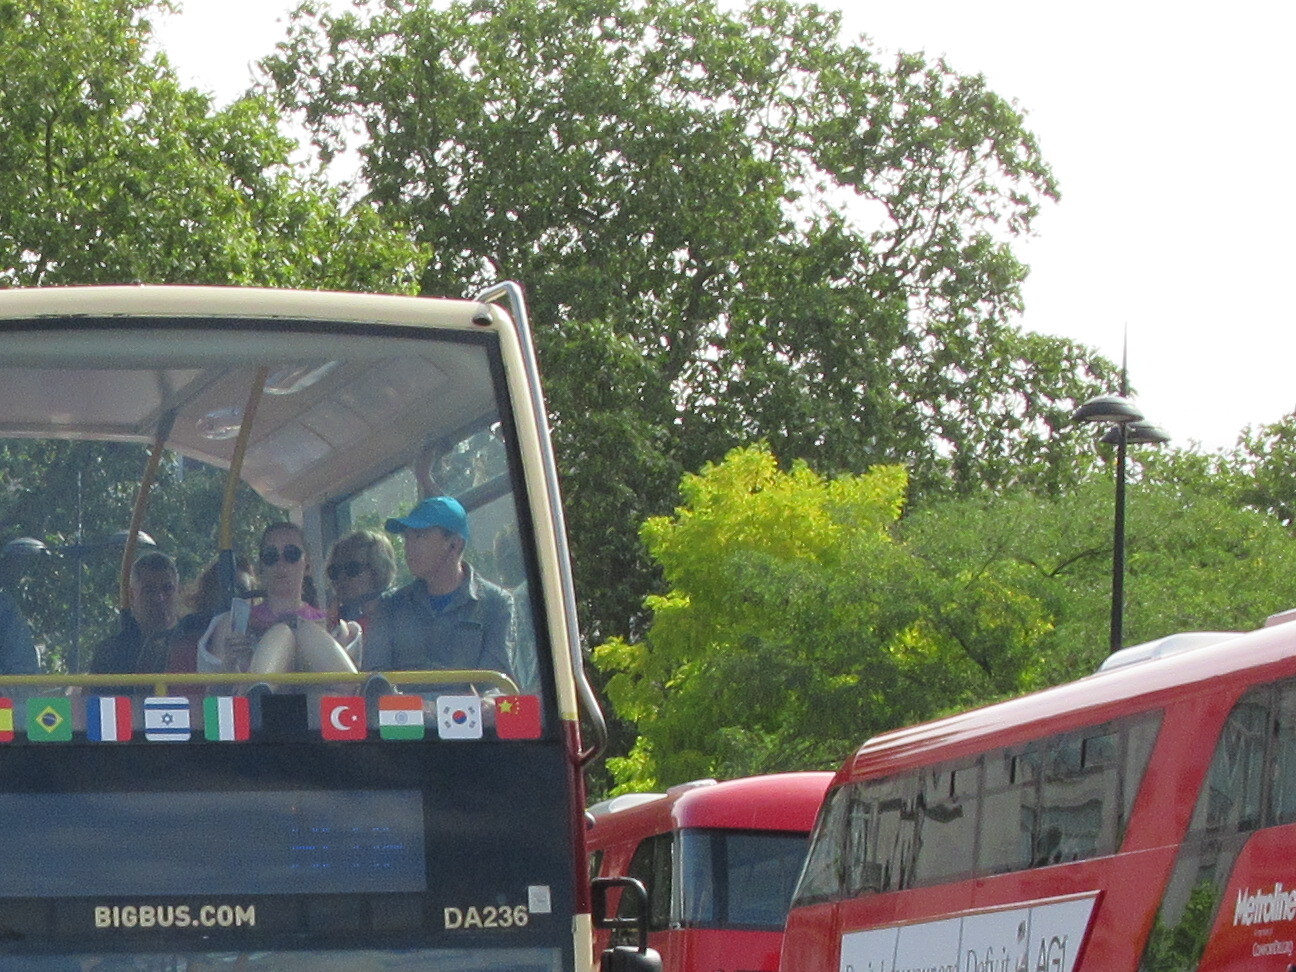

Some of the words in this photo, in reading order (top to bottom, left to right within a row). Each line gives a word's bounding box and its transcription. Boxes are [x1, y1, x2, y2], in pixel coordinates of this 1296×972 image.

[94, 905, 256, 928] BIGBUS.COM
[1233, 882, 1296, 926] Metroline
[444, 905, 529, 930] DA236
